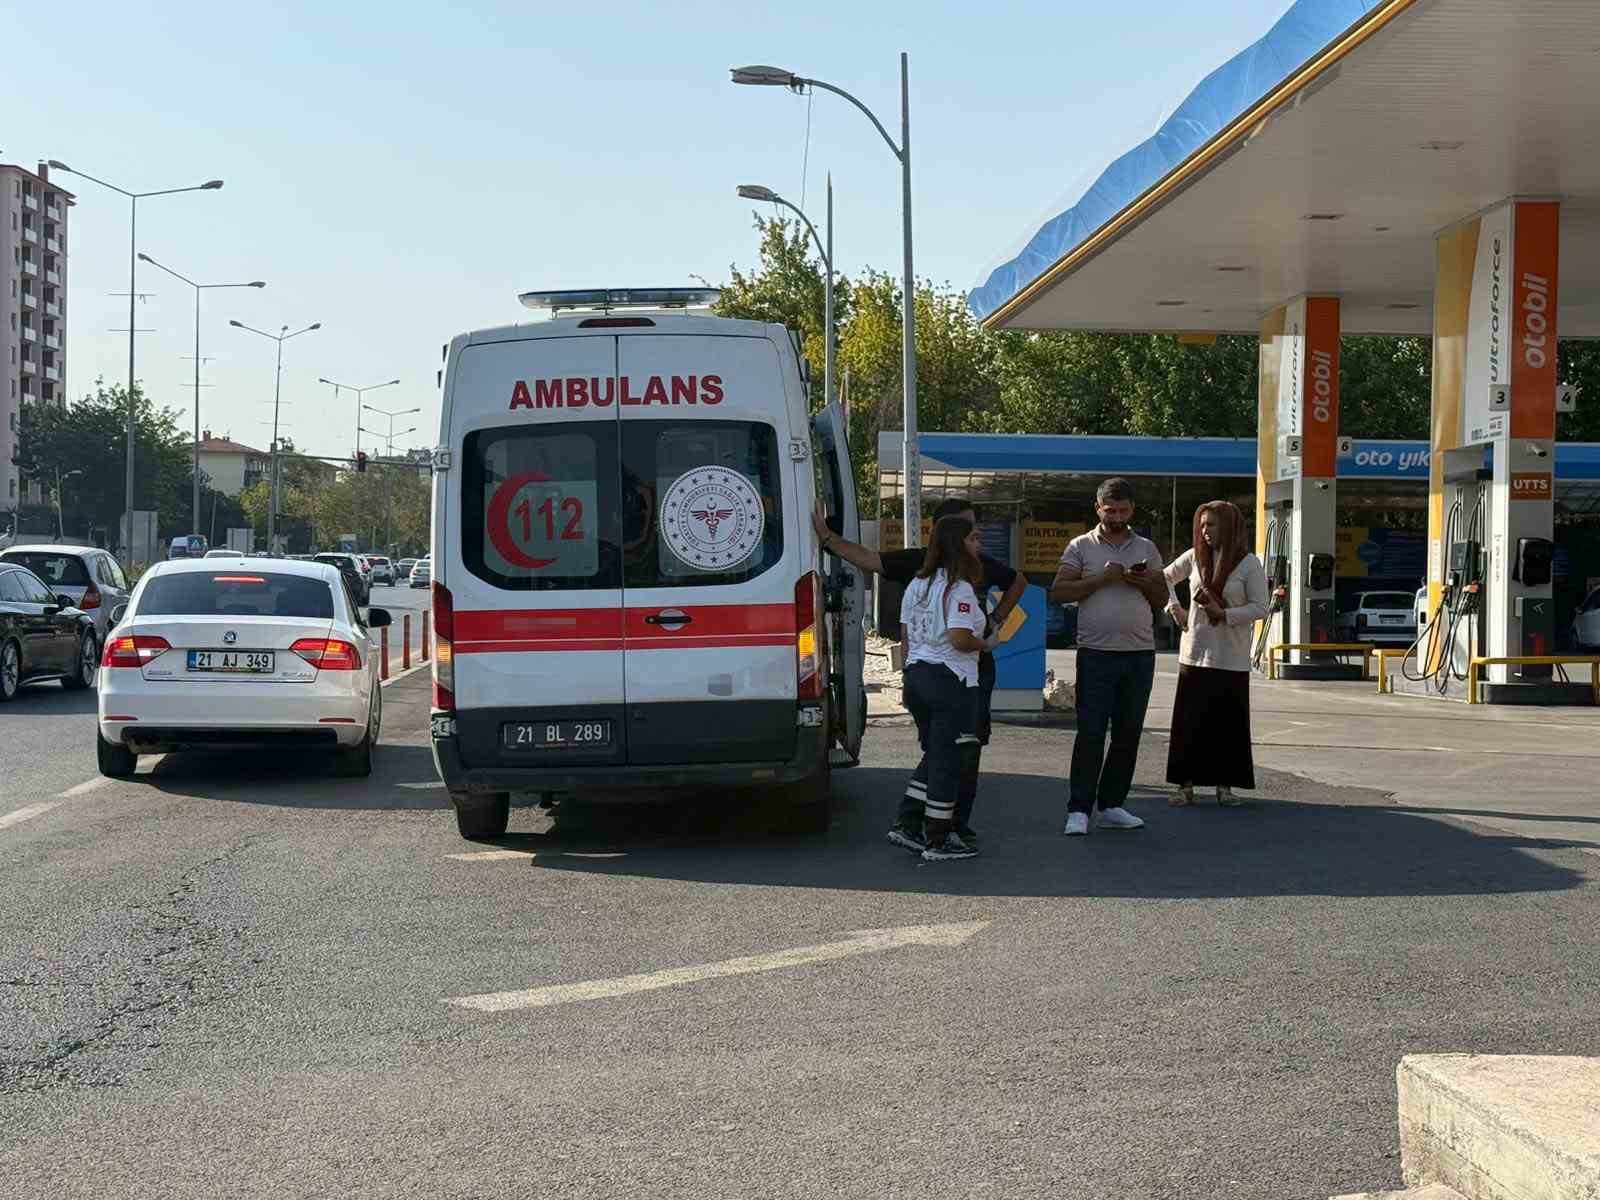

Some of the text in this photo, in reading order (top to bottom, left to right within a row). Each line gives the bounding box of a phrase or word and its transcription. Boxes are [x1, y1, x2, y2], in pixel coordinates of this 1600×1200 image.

[1521, 272, 1549, 369] otobil
[509, 375, 724, 410] AMBULANS
[1312, 350, 1331, 423] otobil
[1496, 391, 1505, 404] 3
[1561, 391, 1572, 404] 4
[1291, 440, 1299, 451] 5
[1341, 441, 1349, 451] 6
[1355, 450, 1393, 466] oto
[1513, 479, 1548, 490] UTTS
[514, 497, 584, 543] 112
[198, 654, 269, 668] 21 AJ 349
[517, 724, 602, 742] 21 BL 289
